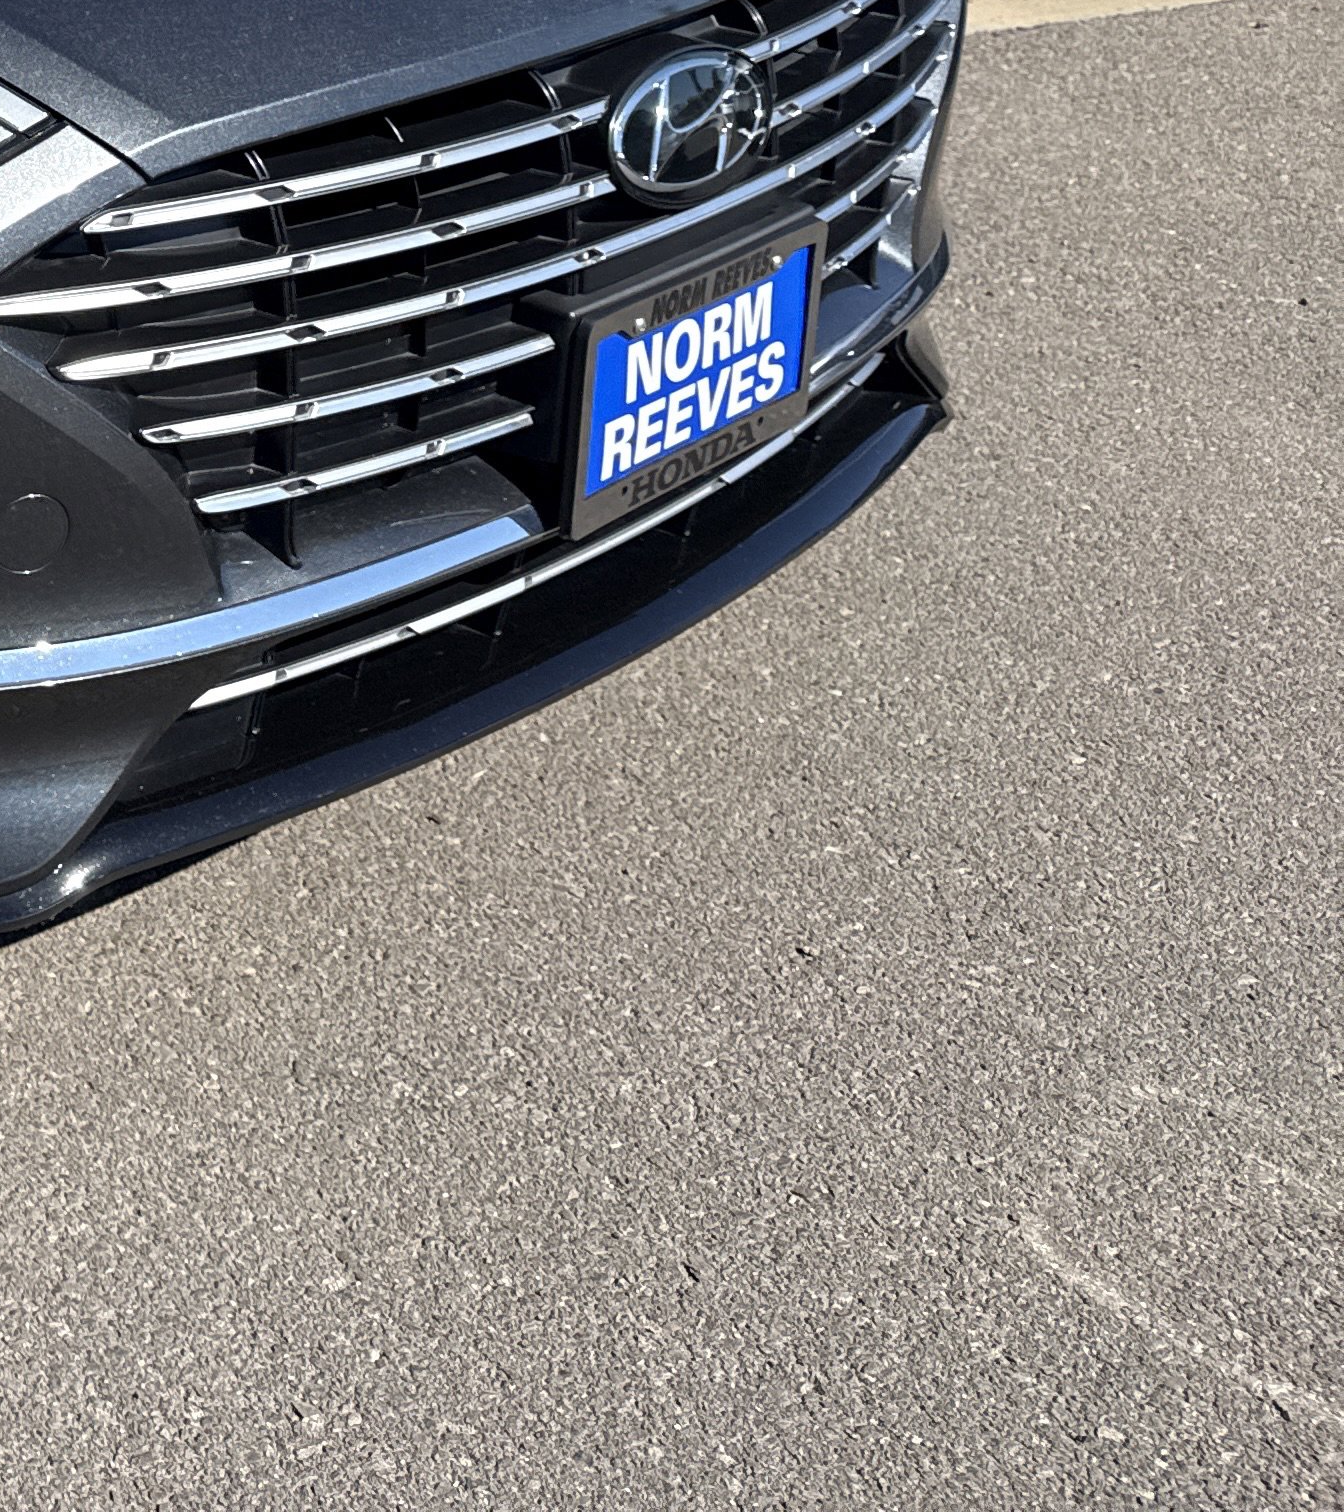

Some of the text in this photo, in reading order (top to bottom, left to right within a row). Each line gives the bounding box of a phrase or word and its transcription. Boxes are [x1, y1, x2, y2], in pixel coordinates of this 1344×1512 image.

[649, 246, 774, 327] NORM REEVES
[625, 280, 774, 405] NORM
[599, 340, 786, 483] REEVES
[628, 420, 755, 508] HONDA
